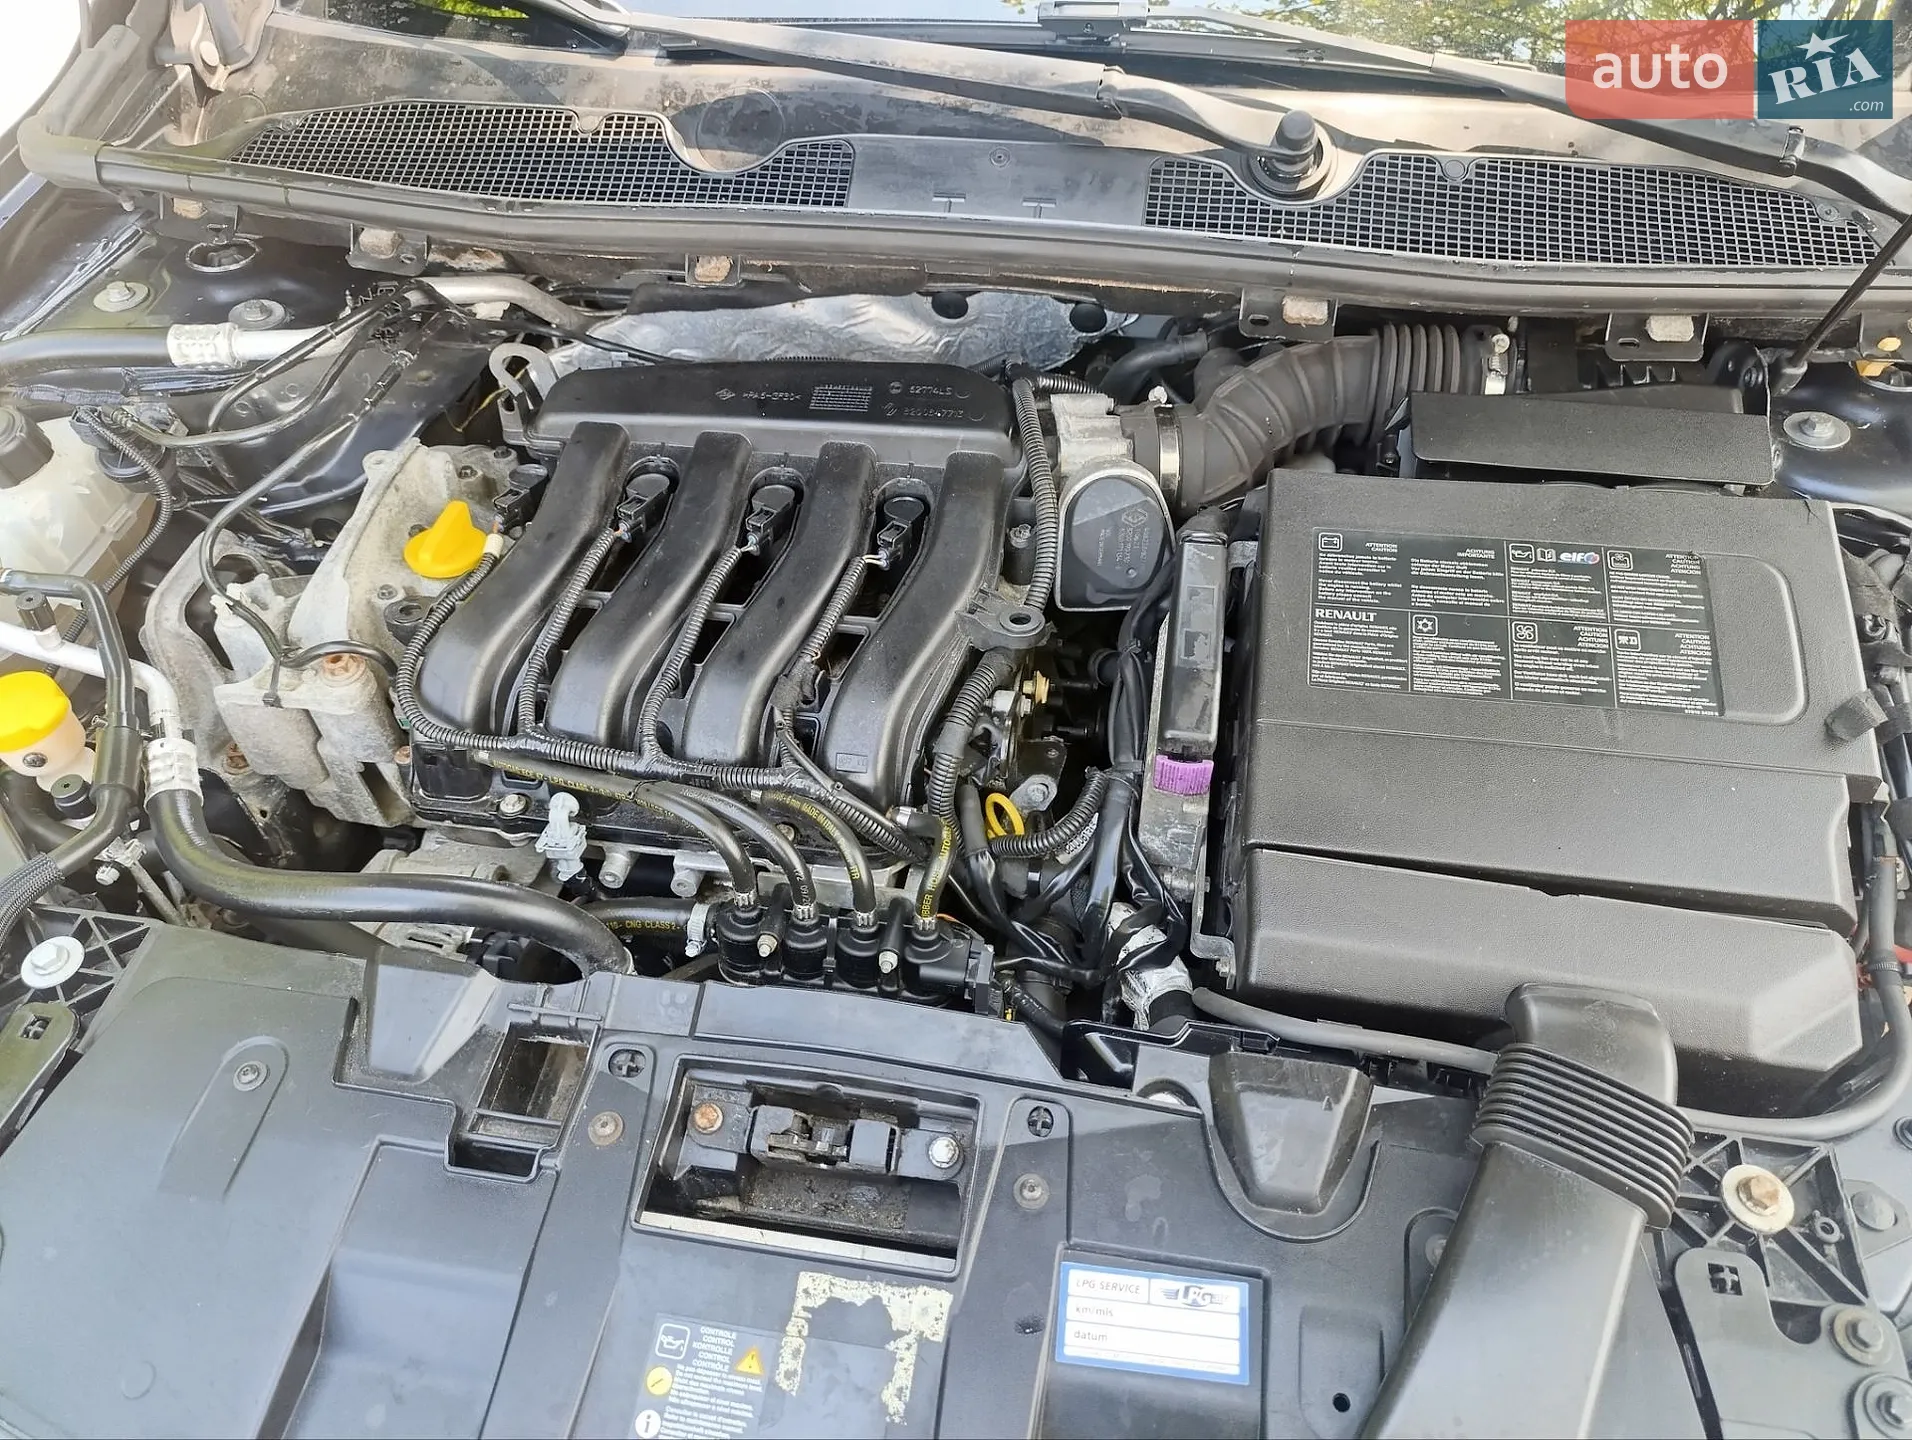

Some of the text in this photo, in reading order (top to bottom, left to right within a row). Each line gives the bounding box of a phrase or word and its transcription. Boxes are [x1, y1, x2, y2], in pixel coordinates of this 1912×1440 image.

[1315, 608, 1377, 622] RENAULT
[802, 803, 819, 818] MADE
[822, 819, 840, 837] ITALY
[927, 865, 943, 891] HOSE
[625, 920, 642, 929] CNG
[645, 921, 670, 930] CLASS
[1076, 1279, 1141, 1295] LPG SERVICE
[1073, 1330, 1108, 1342] datum
